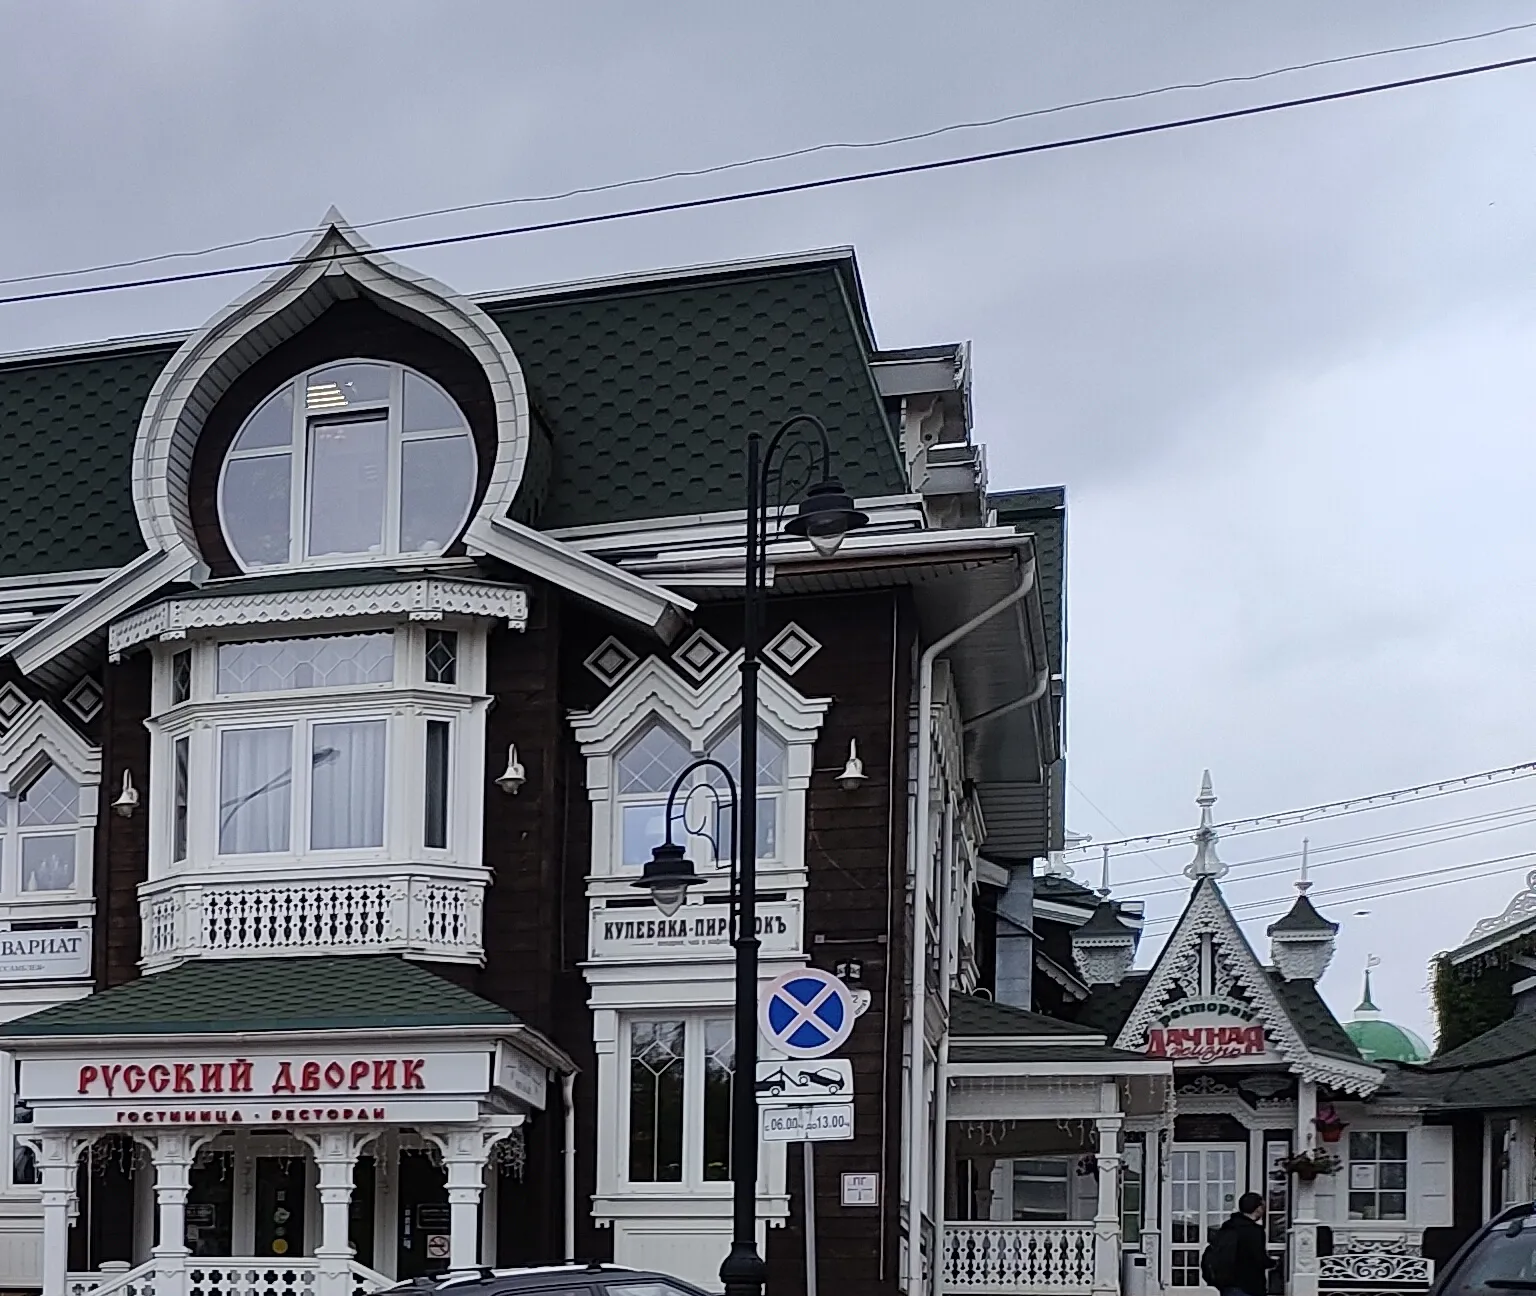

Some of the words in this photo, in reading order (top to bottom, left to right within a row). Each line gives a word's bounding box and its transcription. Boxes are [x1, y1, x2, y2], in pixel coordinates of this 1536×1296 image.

[604, 916, 787, 940] КУЛЕБЯКА-ПИРОКЪ
[1146, 1026, 1266, 1058] ДАЧНАЯ
[78, 1058, 254, 1096] РУССКИЙ
[272, 1059, 426, 1094] ДВОРИК
[117, 1110, 244, 1123] ГОСТИНИЦА
[271, 1107, 386, 1121] РЕСТОРАН
